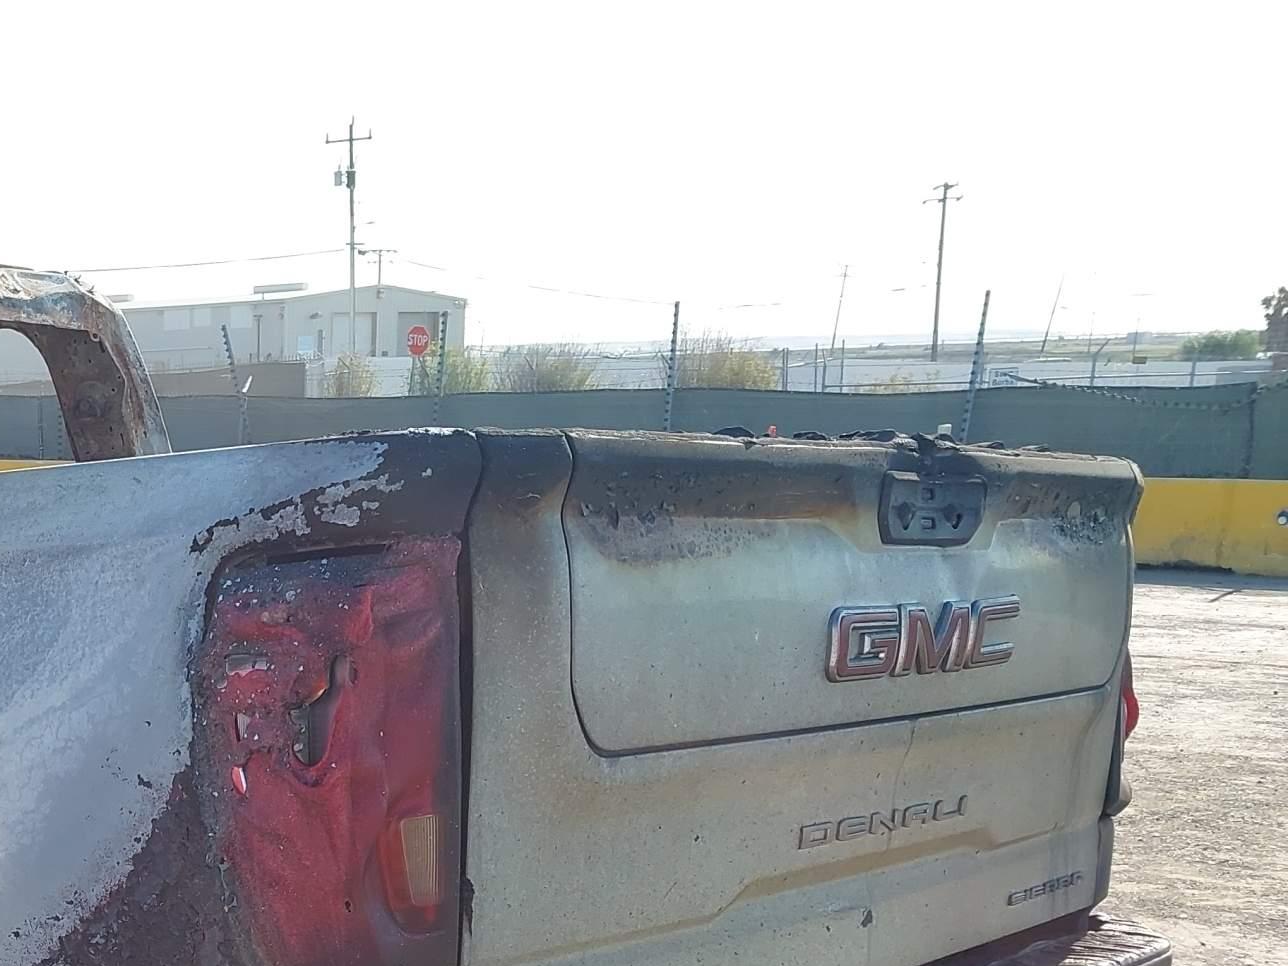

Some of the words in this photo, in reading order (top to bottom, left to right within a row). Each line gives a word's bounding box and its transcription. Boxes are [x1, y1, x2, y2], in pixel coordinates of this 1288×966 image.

[407, 334, 429, 346] STOP
[825, 594, 1021, 683] GMC
[798, 794, 968, 850] DENALI
[1007, 870, 1083, 907] SIERRA
